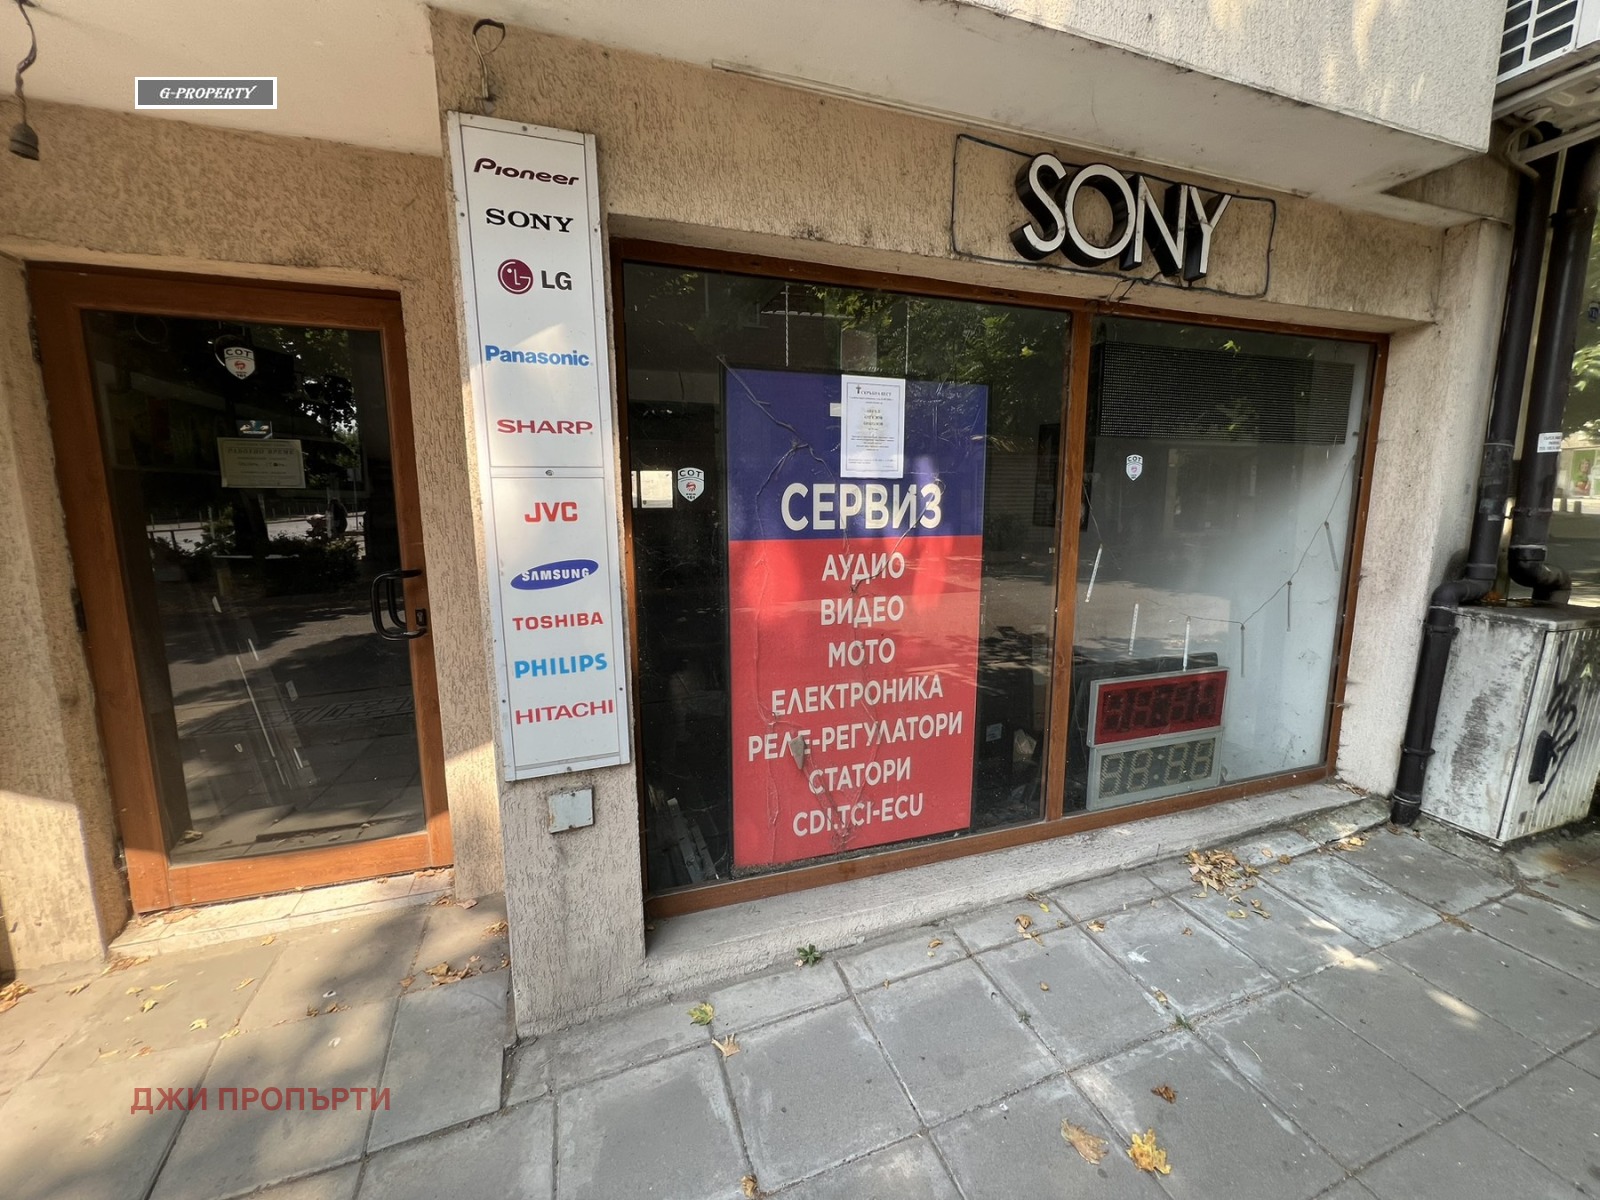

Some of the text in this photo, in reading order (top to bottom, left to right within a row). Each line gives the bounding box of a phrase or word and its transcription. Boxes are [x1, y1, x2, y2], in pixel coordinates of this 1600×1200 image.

[473, 158, 579, 185] Pioneer
[486, 208, 574, 233] SONY
[1012, 153, 1233, 280] SONY
[541, 270, 573, 291] LG
[484, 345, 590, 367] Panasonic
[496, 419, 593, 435] SHARP
[524, 501, 578, 523] JVC
[781, 482, 942, 531] СЕРВИЗ
[521, 567, 590, 582] SAMSUNG
[821, 551, 905, 585] АУДИО
[512, 611, 604, 631] TOSHIBA
[820, 594, 904, 628] ВИДЕО
[514, 652, 608, 679] PHILIPS
[828, 638, 896, 668] МОТО
[771, 674, 943, 716] ЕЛЕКТРОНИКА
[515, 699, 614, 725] HITACHI
[808, 756, 911, 795] СТАТОРИ
